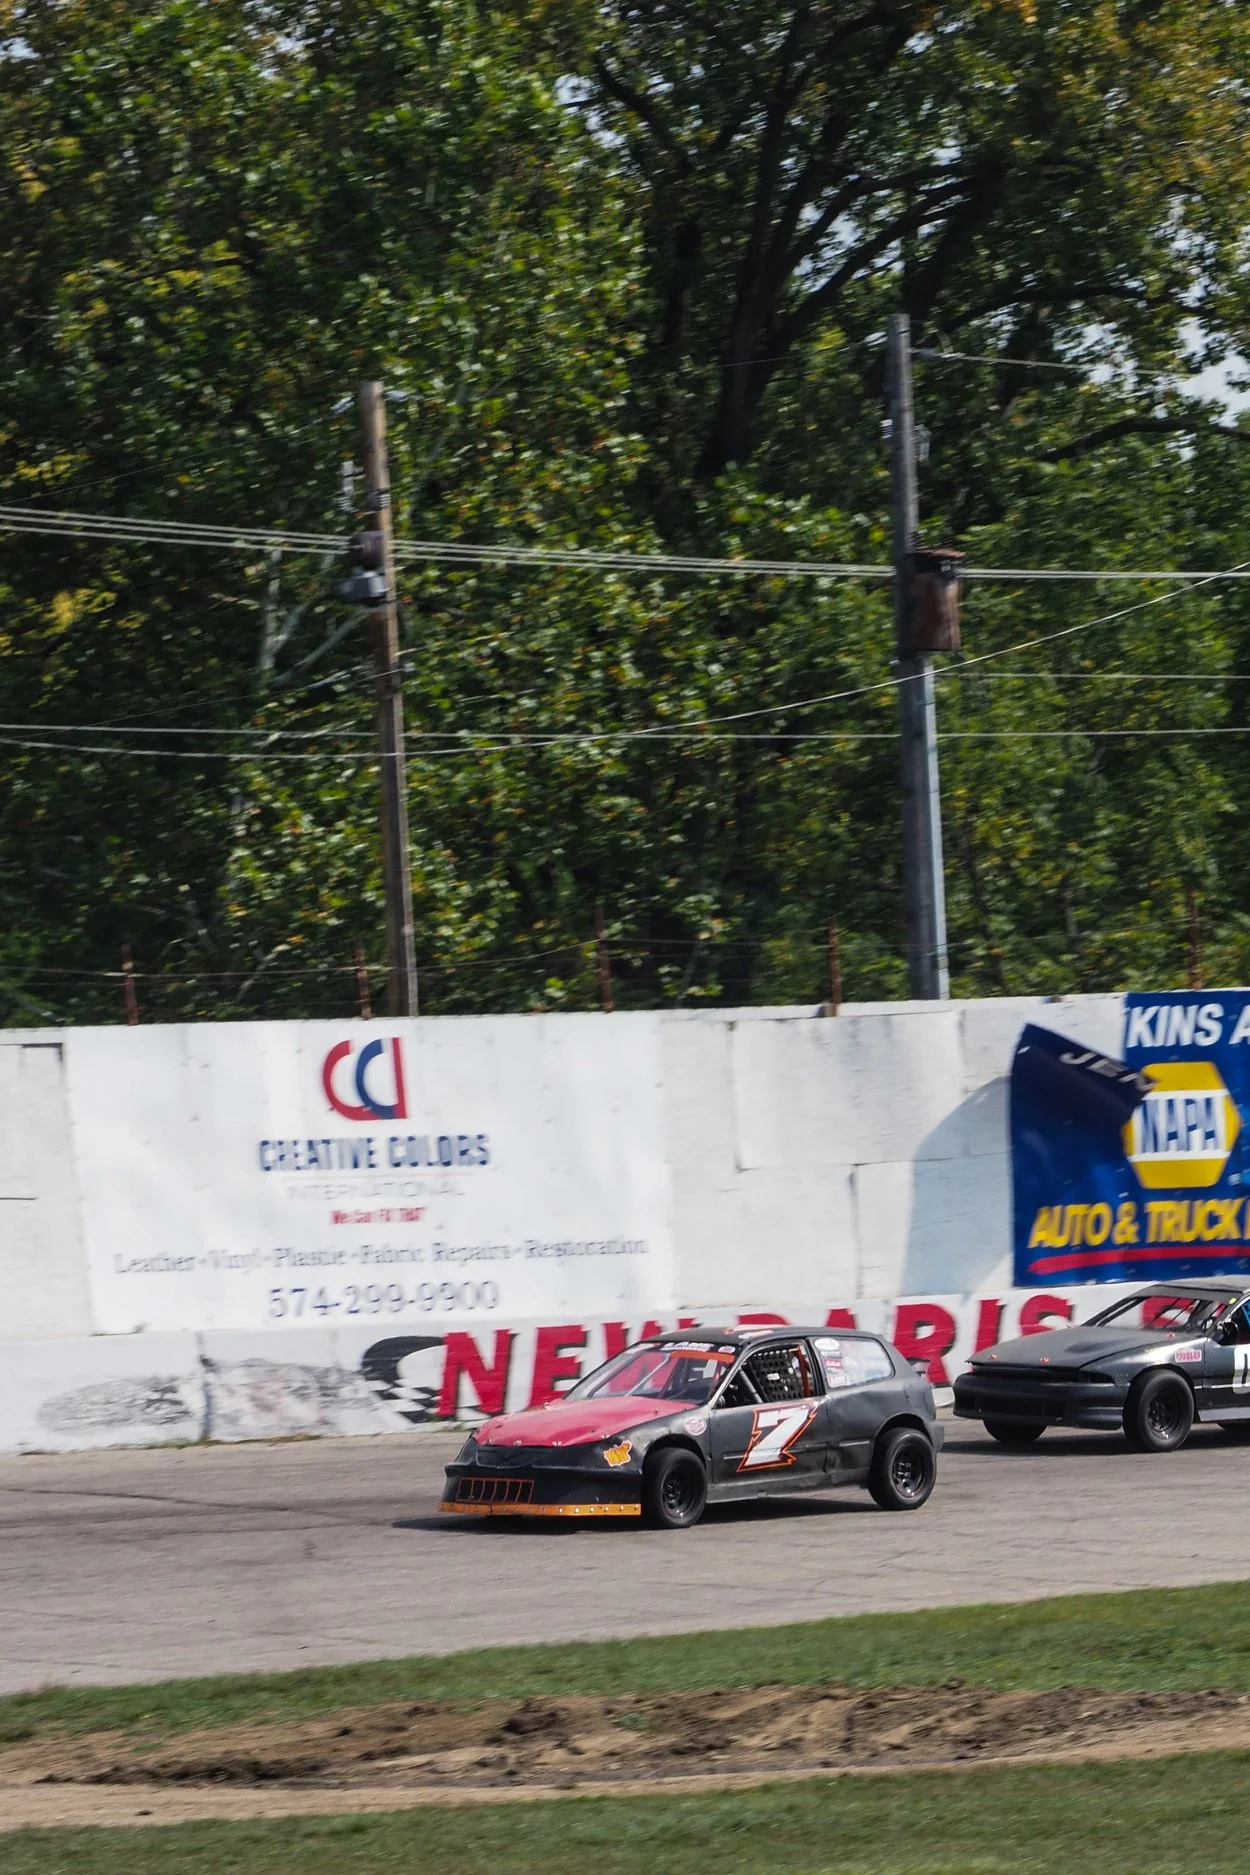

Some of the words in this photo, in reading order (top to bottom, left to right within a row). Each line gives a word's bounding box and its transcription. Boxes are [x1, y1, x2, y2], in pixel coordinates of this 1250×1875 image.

[1140, 1095, 1221, 1155] NAPA
[260, 1136, 377, 1172] CREATIVE
[388, 1133, 489, 1169] COLORS
[1028, 1201, 1113, 1249] AUTO
[1113, 1200, 1140, 1246] &
[1144, 1196, 1249, 1244] TRUCK
[268, 1280, 499, 1318] 574-299-9900
[738, 1399, 817, 1471] 7
